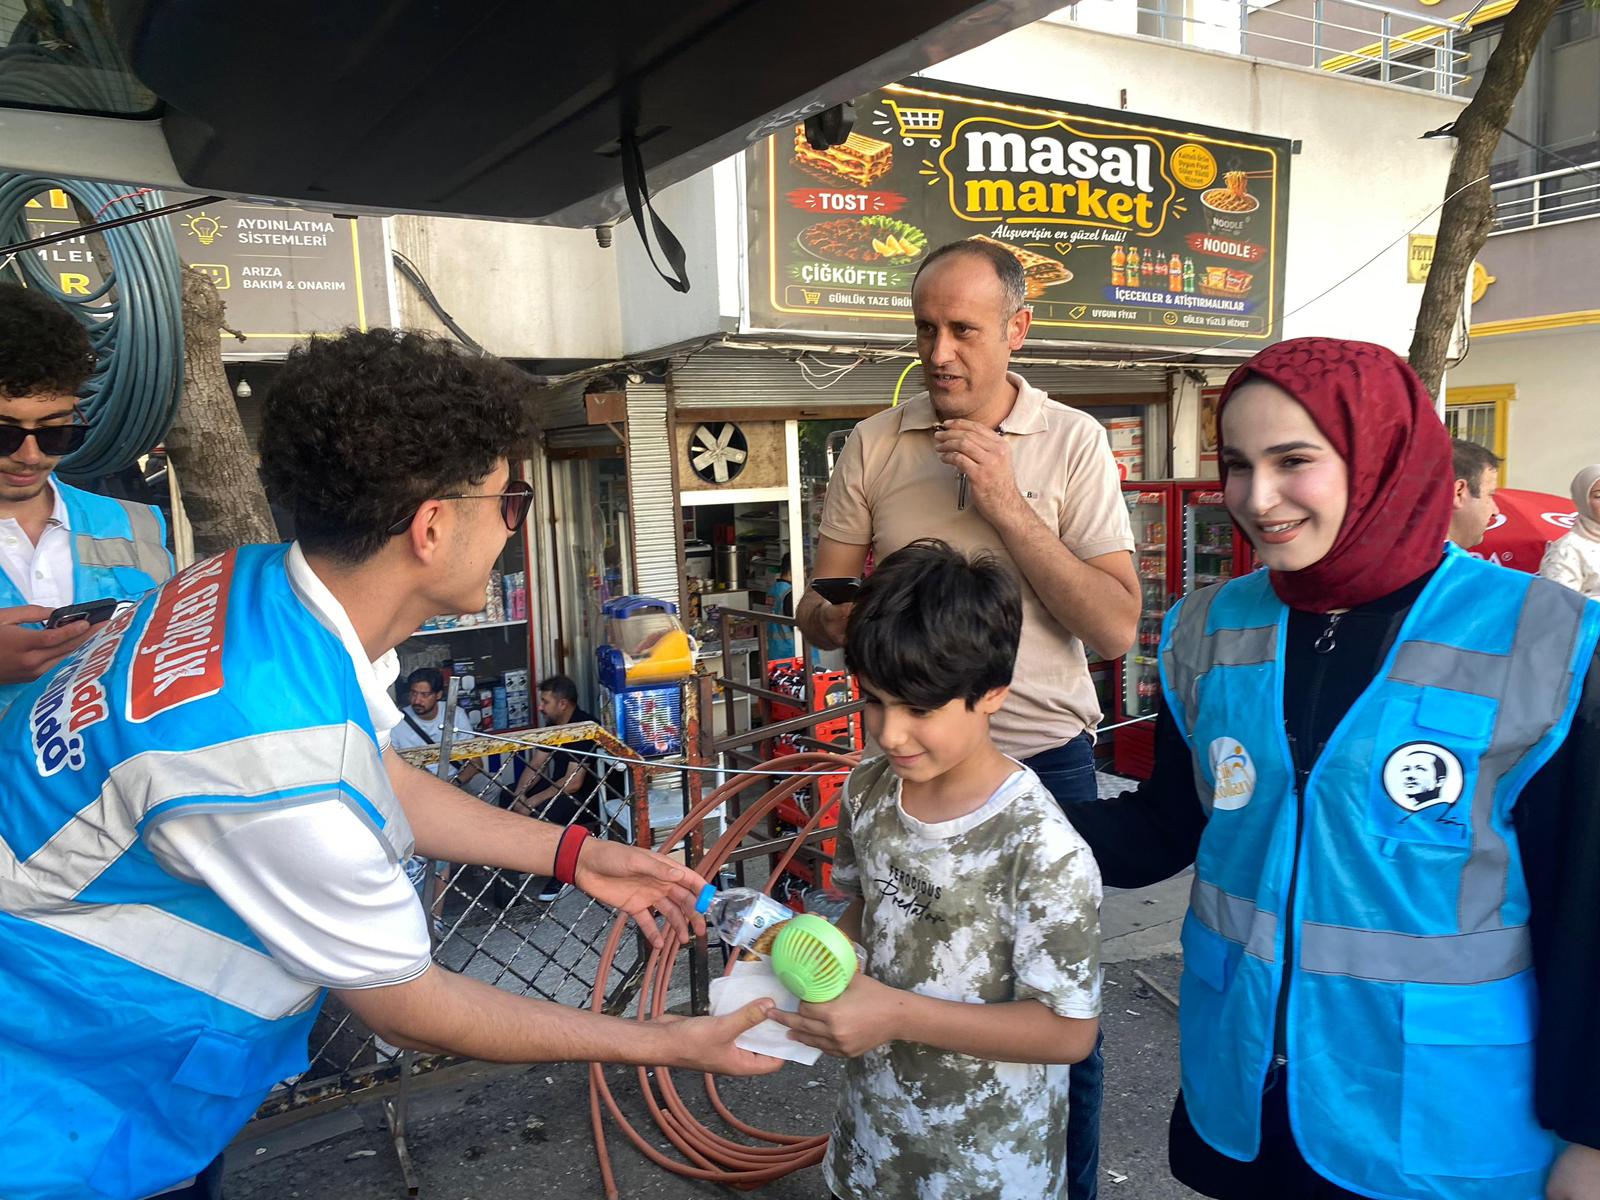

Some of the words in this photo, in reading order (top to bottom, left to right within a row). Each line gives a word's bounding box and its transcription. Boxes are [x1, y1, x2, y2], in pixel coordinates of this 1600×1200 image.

[965, 131, 1154, 193] masal
[818, 193, 869, 211] TOST
[965, 179, 1153, 229] market
[237, 218, 335, 233] AYDINLATMA
[1213, 217, 1244, 230] NOODLE
[238, 231, 327, 247] SİSTEMLERİ
[991, 224, 1052, 241] Alışverişin
[1054, 230, 1067, 239] en
[1070, 229, 1100, 244] güzel
[1101, 230, 1128, 243] hali!
[1203, 237, 1251, 258] NOODLE
[241, 266, 282, 277] ARIZA
[801, 263, 888, 287] ÇİĞKÖFTE
[243, 279, 284, 290] BAKIM
[286, 280, 296, 290] &
[297, 281, 346, 291] ONARIM
[828, 292, 866, 305] GÜNLÜK
[867, 297, 890, 307] TAZE
[1115, 287, 1164, 305] İÇECEKLER
[1165, 295, 1173, 304] &
[1092, 308, 1118, 319] UYGUN
[141, 582, 220, 697] GENÇLİK
[889, 865, 942, 899] FEROCIOUS
[873, 879, 946, 925] Predator
